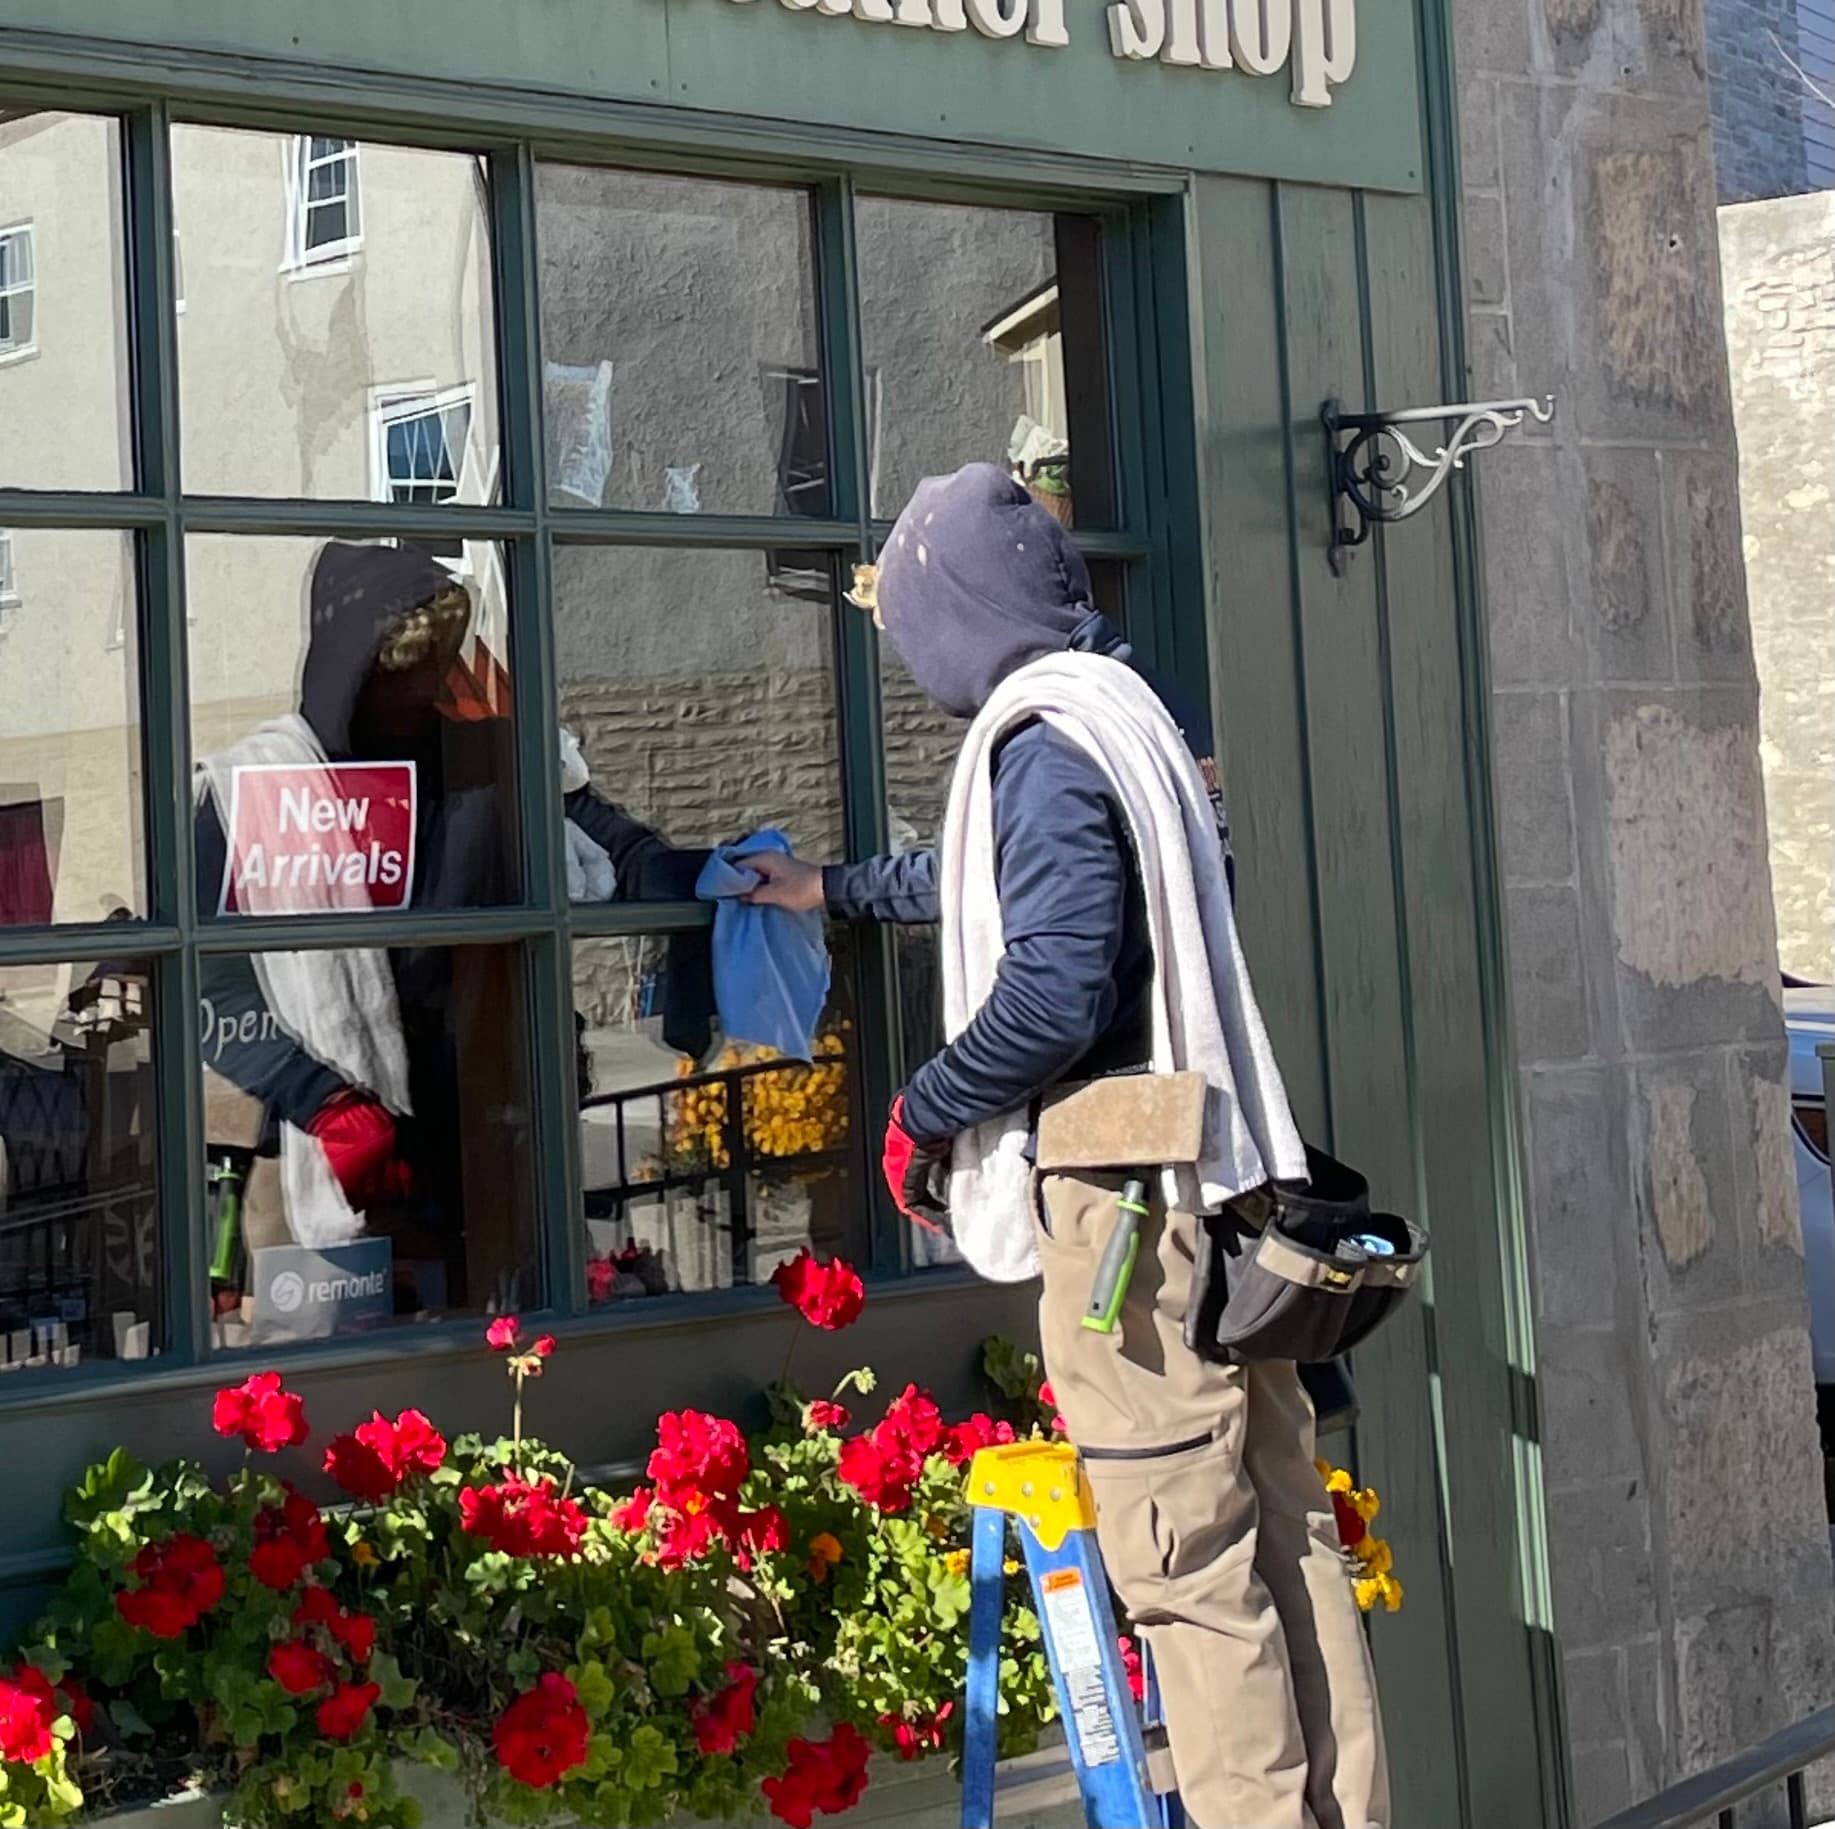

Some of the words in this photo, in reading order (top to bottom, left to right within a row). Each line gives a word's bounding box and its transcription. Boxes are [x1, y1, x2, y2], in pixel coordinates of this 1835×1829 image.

[278, 787, 370, 833] New
[237, 840, 402, 889] Arrivals
[307, 1271, 385, 1302] remonte
